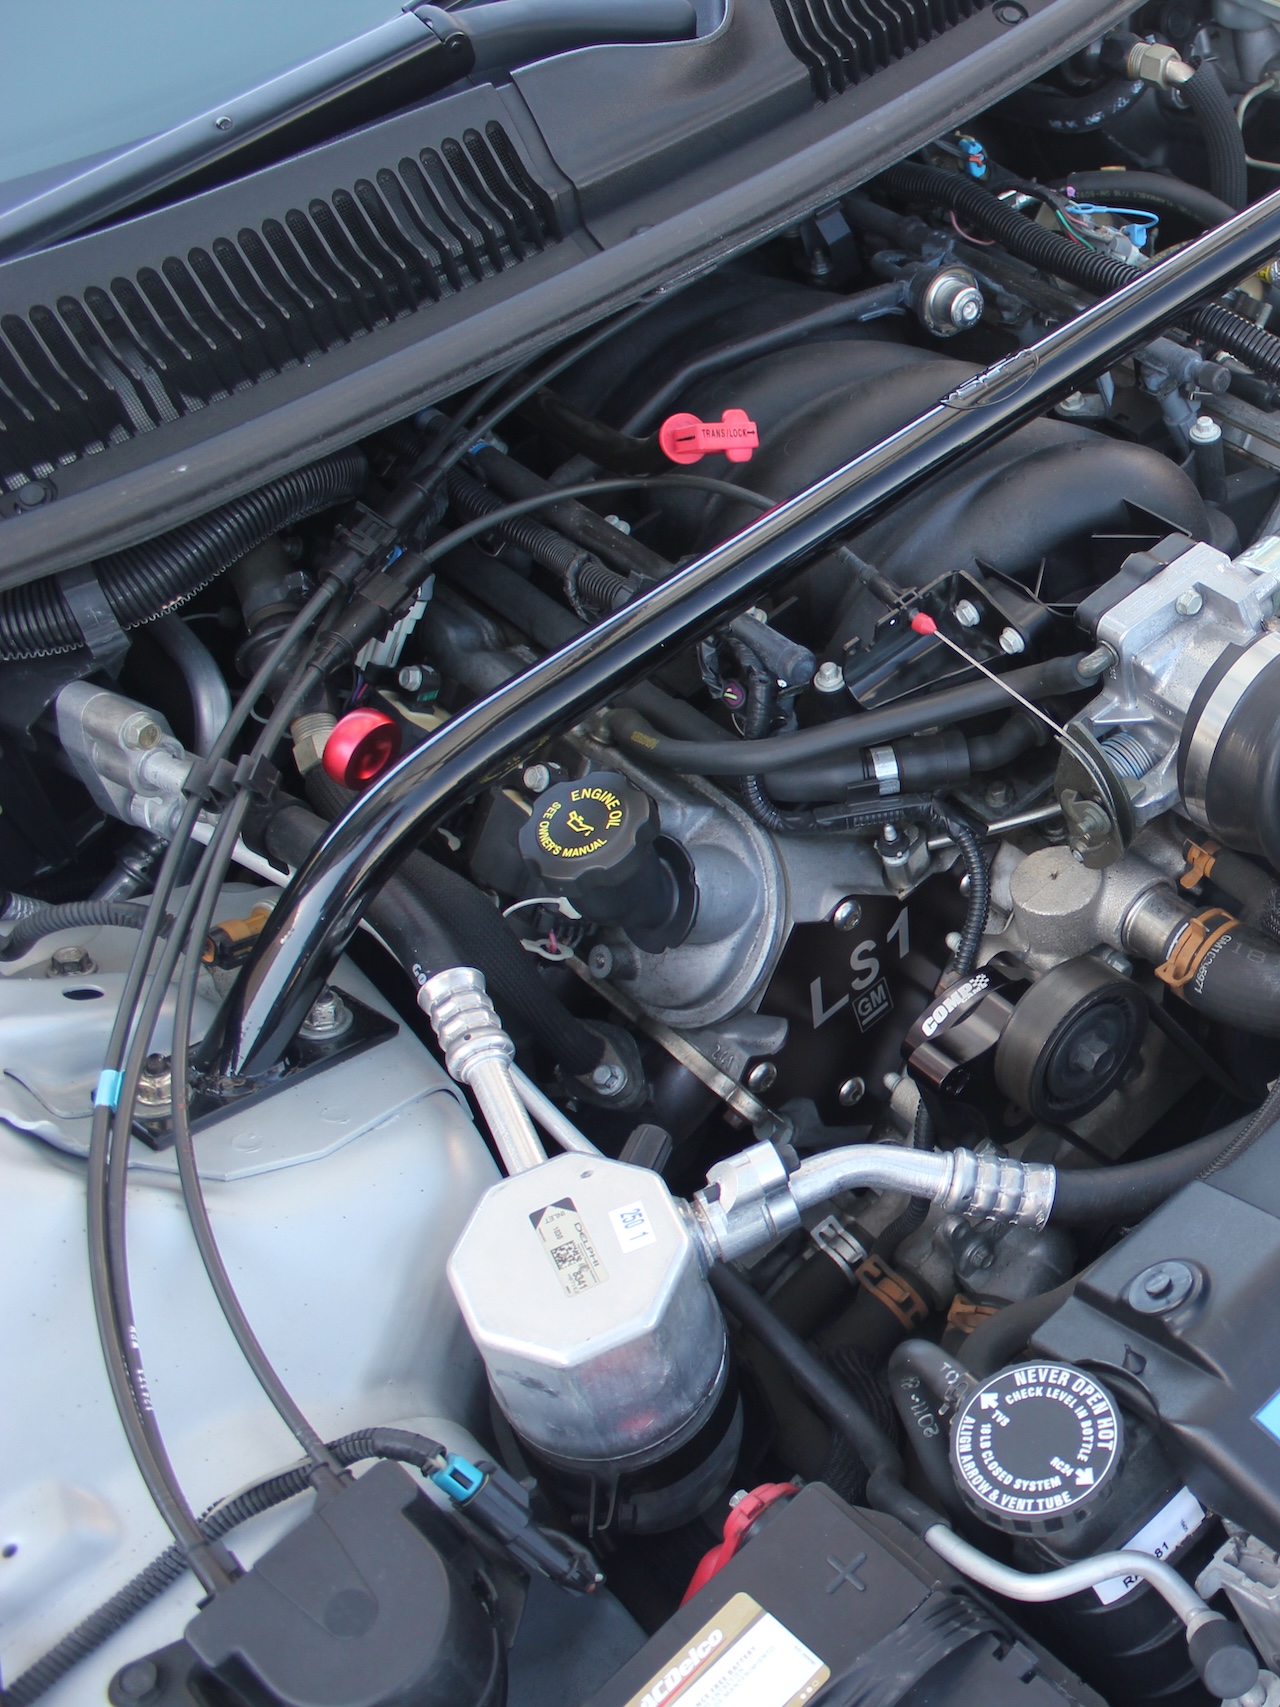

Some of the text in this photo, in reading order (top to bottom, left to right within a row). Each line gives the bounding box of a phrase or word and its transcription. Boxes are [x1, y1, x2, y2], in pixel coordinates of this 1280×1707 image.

[702, 429, 747, 438] TRANS/LOCK
[571, 788, 623, 830] ENGINE OIL
[538, 801, 608, 858] SEE OWNER'S MANUAL
[857, 985, 887, 1018] GM
[922, 983, 973, 1037] COMP
[544, 1210, 565, 1224] INLET
[620, 1208, 649, 1240] 250 1
[574, 1222, 599, 1267] DELPHI
[572, 1270, 588, 1289] 8341
[991, 1409, 1011, 1427] TVS
[1005, 1386, 1094, 1463] CHECK LEVEL IN BOTTLE
[1014, 1368, 1114, 1451] NEVER OPEN HOT
[980, 1435, 992, 1449] LB
[959, 1415, 1072, 1511] ALIGN ARROW & VENT TUBE
[981, 1450, 1014, 1485] CLOSED
[1050, 1456, 1075, 1477] RC24
[1013, 1475, 1062, 1492] SYSTEM
[639, 1628, 723, 1707] ACDelco
[709, 1674, 727, 1693] FREE
[726, 1644, 757, 1675] BATTERY
